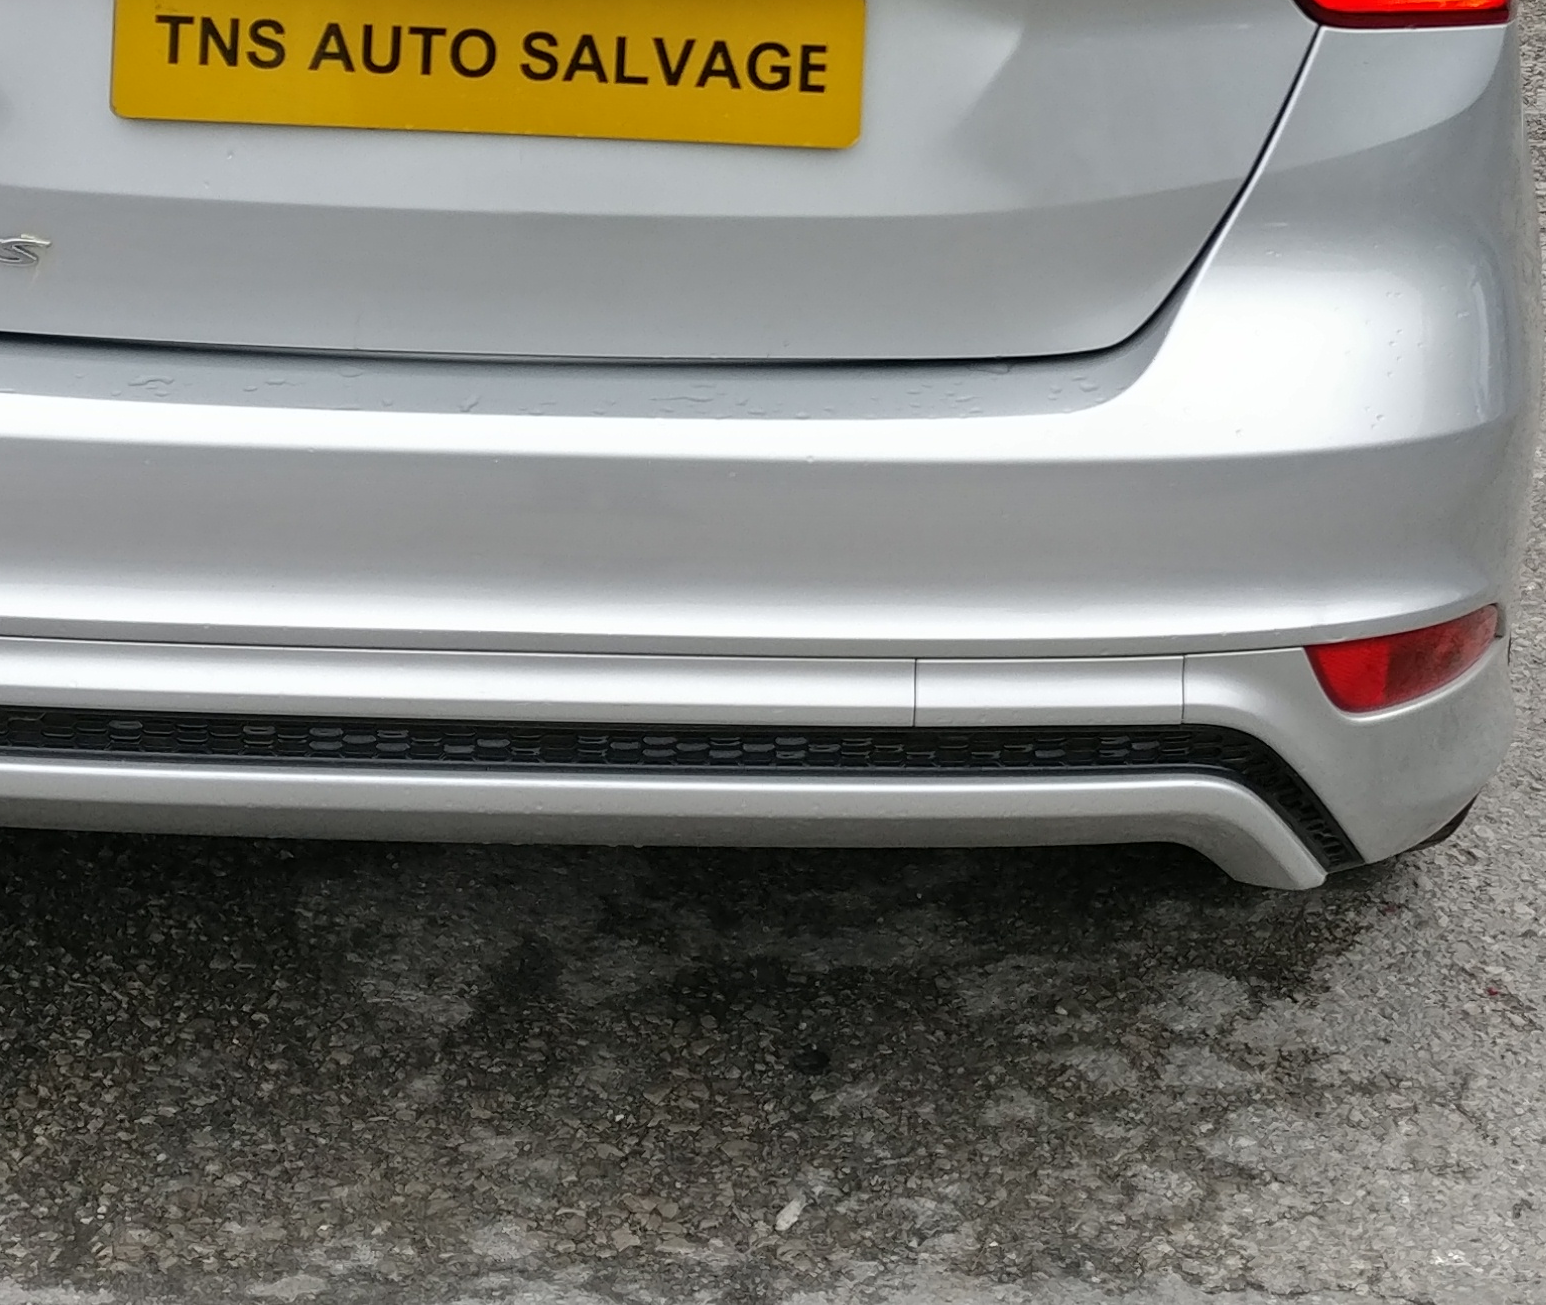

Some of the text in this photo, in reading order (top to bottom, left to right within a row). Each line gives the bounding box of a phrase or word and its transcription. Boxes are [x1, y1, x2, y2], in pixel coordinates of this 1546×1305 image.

[155, 14, 828, 94] TNS AUTO SALVAGE
